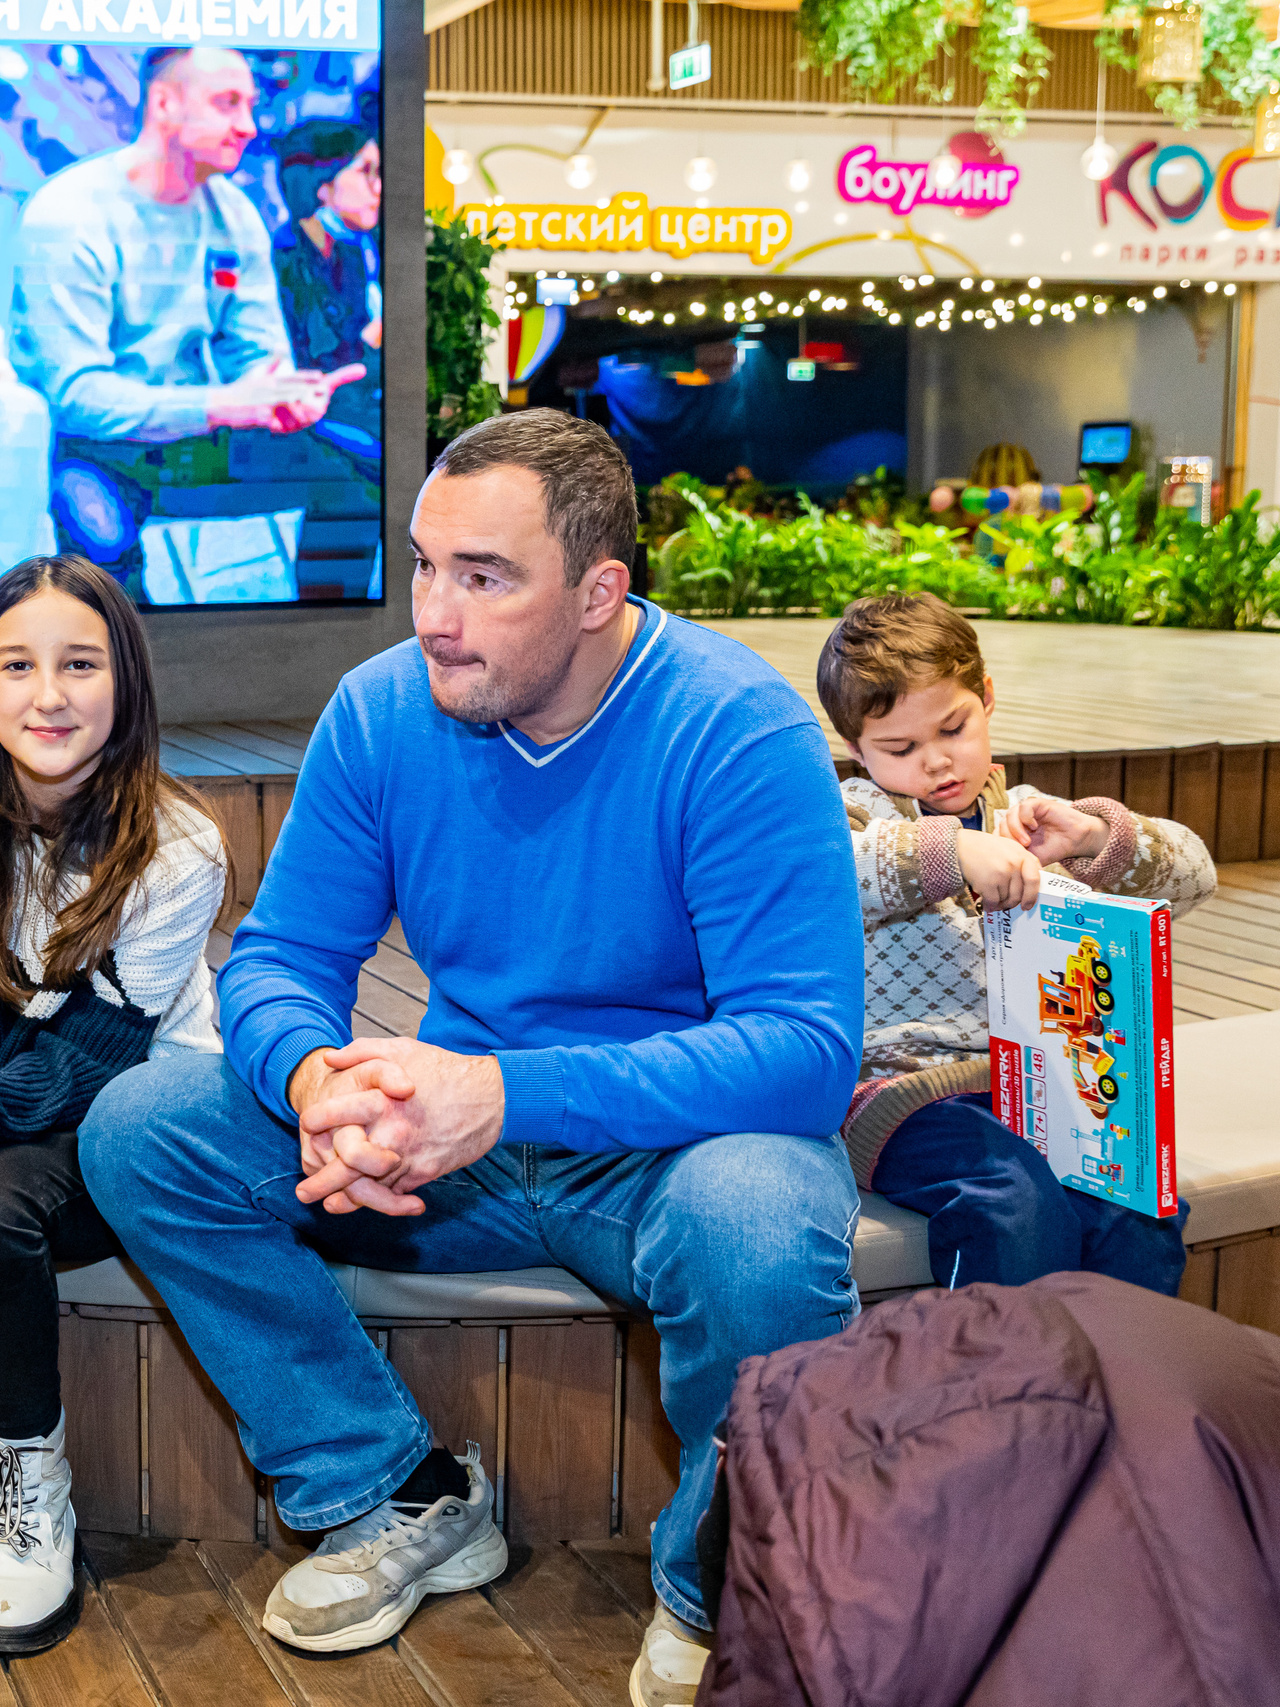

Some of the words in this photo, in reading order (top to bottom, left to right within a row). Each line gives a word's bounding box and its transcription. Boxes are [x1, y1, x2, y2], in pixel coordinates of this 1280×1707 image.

[40, 0, 358, 41] АКАДЕМИЯ
[844, 149, 1018, 210] боулинг
[1100, 141, 1280, 232] КОС
[660, 212, 788, 257] центр
[1120, 244, 1208, 267] парки
[1047, 877, 1090, 896] ГРЕЙДЕР
[1001, 908, 1013, 949] ГРЕЙД
[1158, 914, 1167, 947] RT-001
[1013, 1049, 1021, 1074] puzzle
[1033, 1053, 1043, 1073] 48
[1159, 1037, 1171, 1088] ГРЕЙДЕР
[1034, 1115, 1045, 1133] 7+
